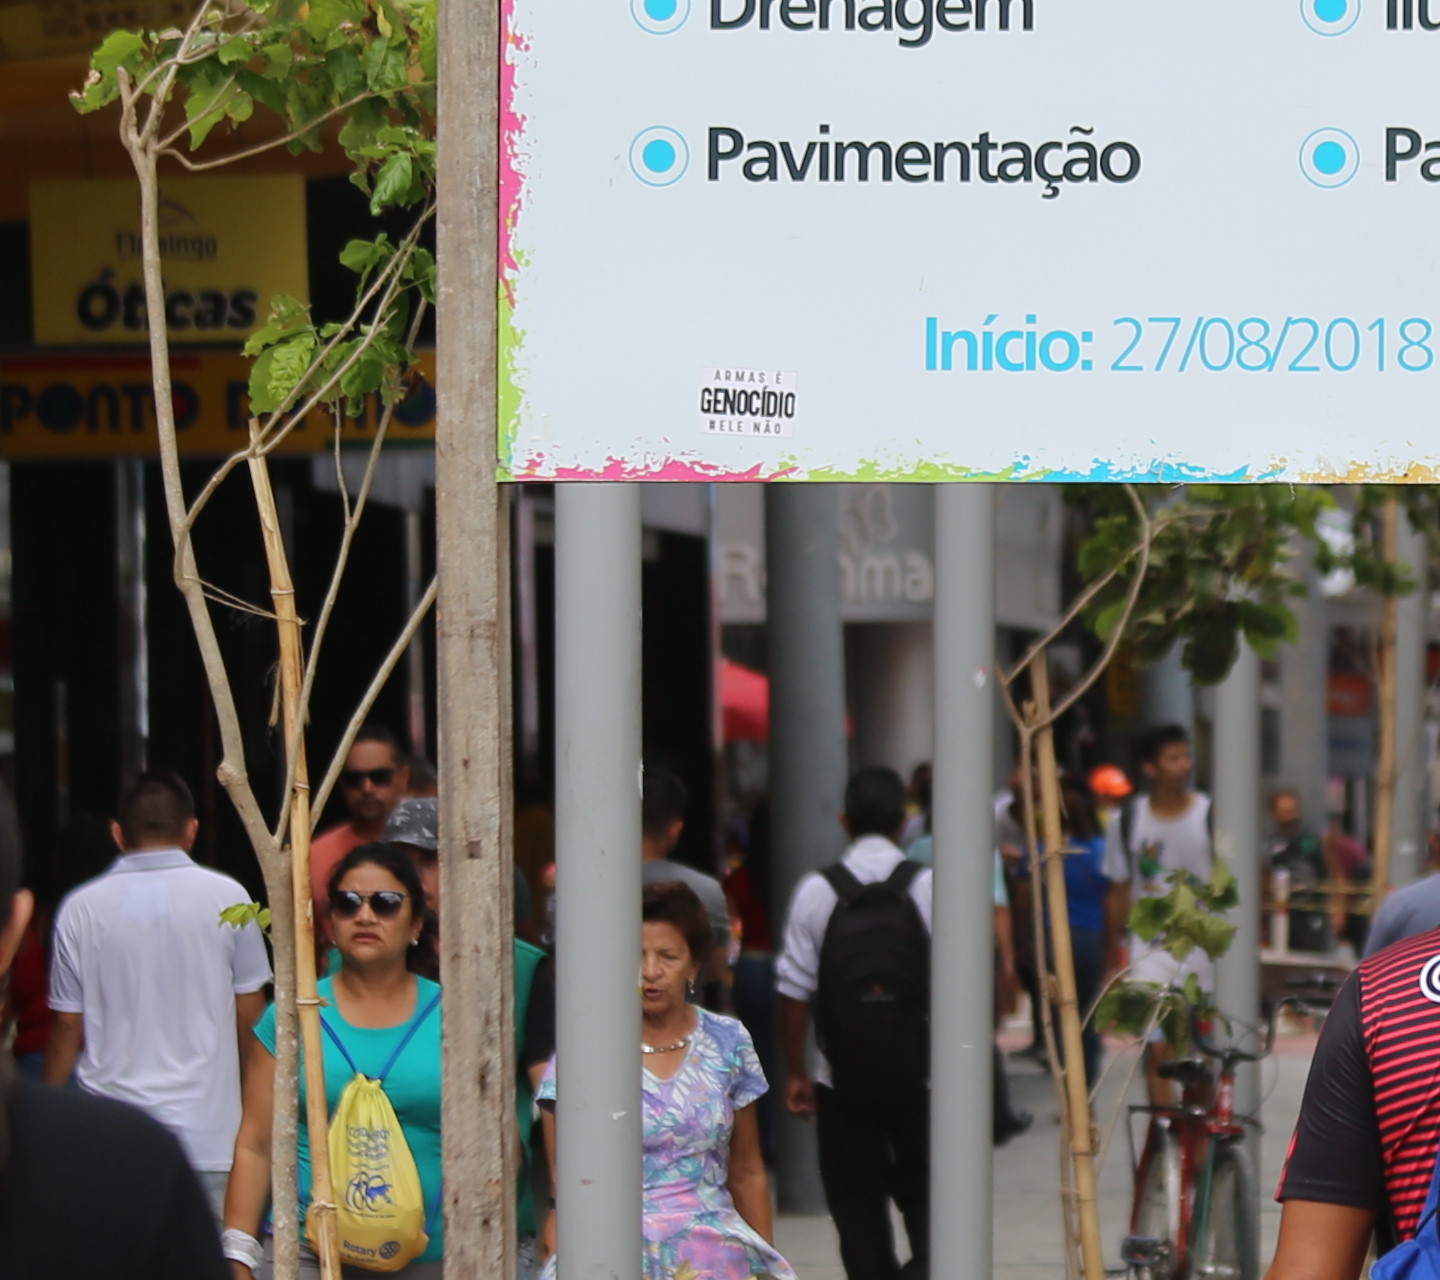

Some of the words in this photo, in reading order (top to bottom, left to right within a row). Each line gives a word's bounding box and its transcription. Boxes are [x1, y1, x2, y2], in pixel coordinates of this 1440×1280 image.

[708, 126, 1141, 199] Pavimentação
[76, 269, 259, 333] Ótcas
[926, 315, 1093, 372] Início:
[1111, 317, 1434, 373] 27/08/2018
[713, 369, 766, 384] ARMAS
[775, 371, 782, 385] É
[700, 386, 796, 419] GENOCÍDIO
[753, 419, 782, 435] NÃO
[343, 1239, 377, 1258] Rotary
